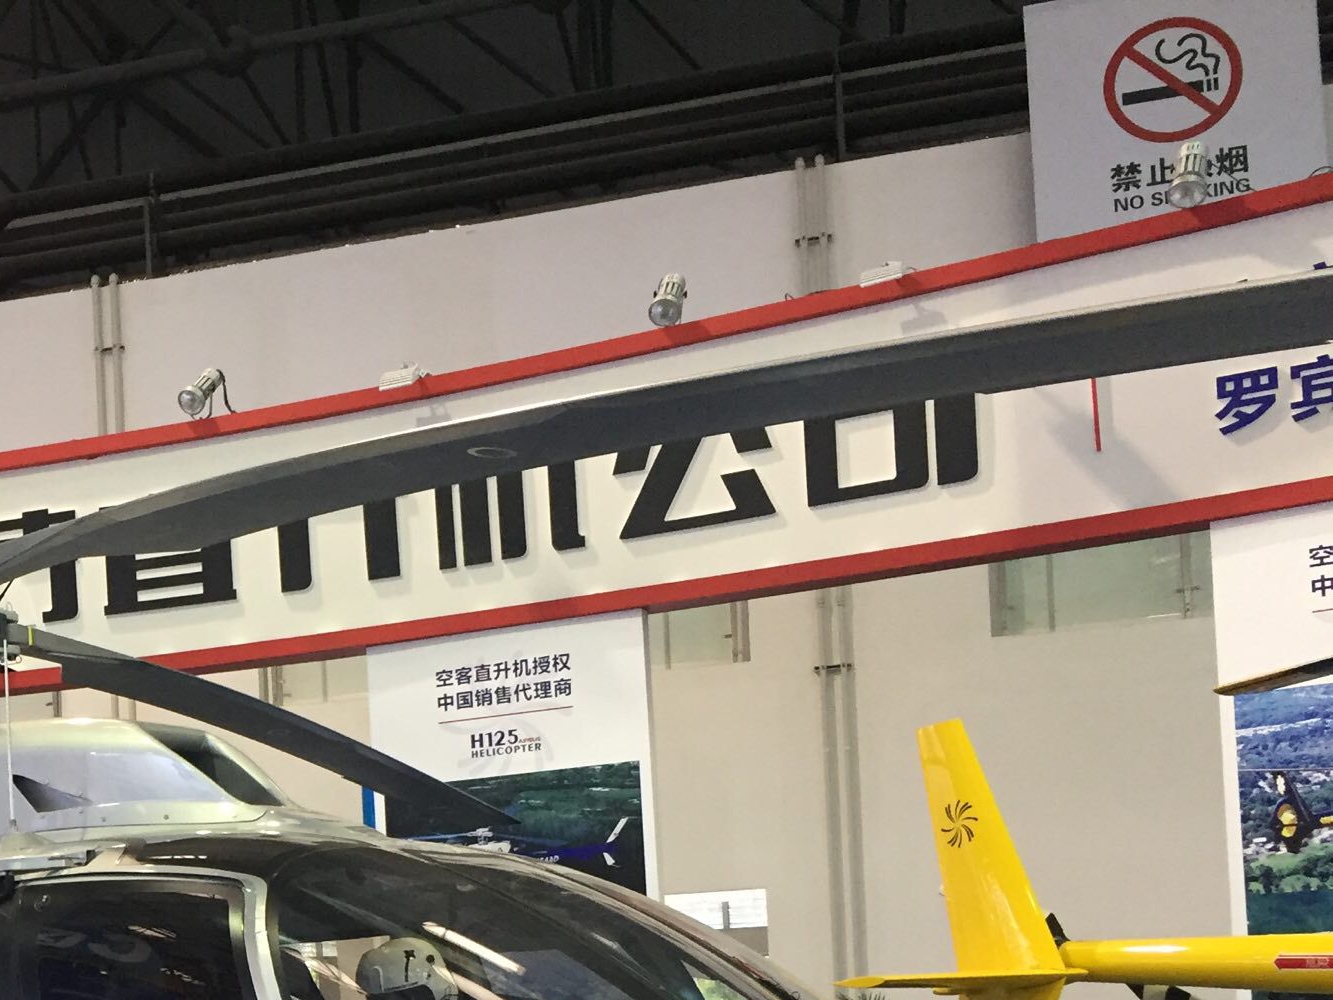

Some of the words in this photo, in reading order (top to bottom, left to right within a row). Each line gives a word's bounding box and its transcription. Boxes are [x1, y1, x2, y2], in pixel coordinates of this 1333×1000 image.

[1110, 145, 1249, 193] 禁止烟
[1114, 195, 1145, 213] NO
[436, 653, 571, 688] 空客直升机授权
[437, 678, 572, 712] 中国销售代理商
[470, 729, 518, 749] H125
[471, 742, 542, 758] HELICOPTER
